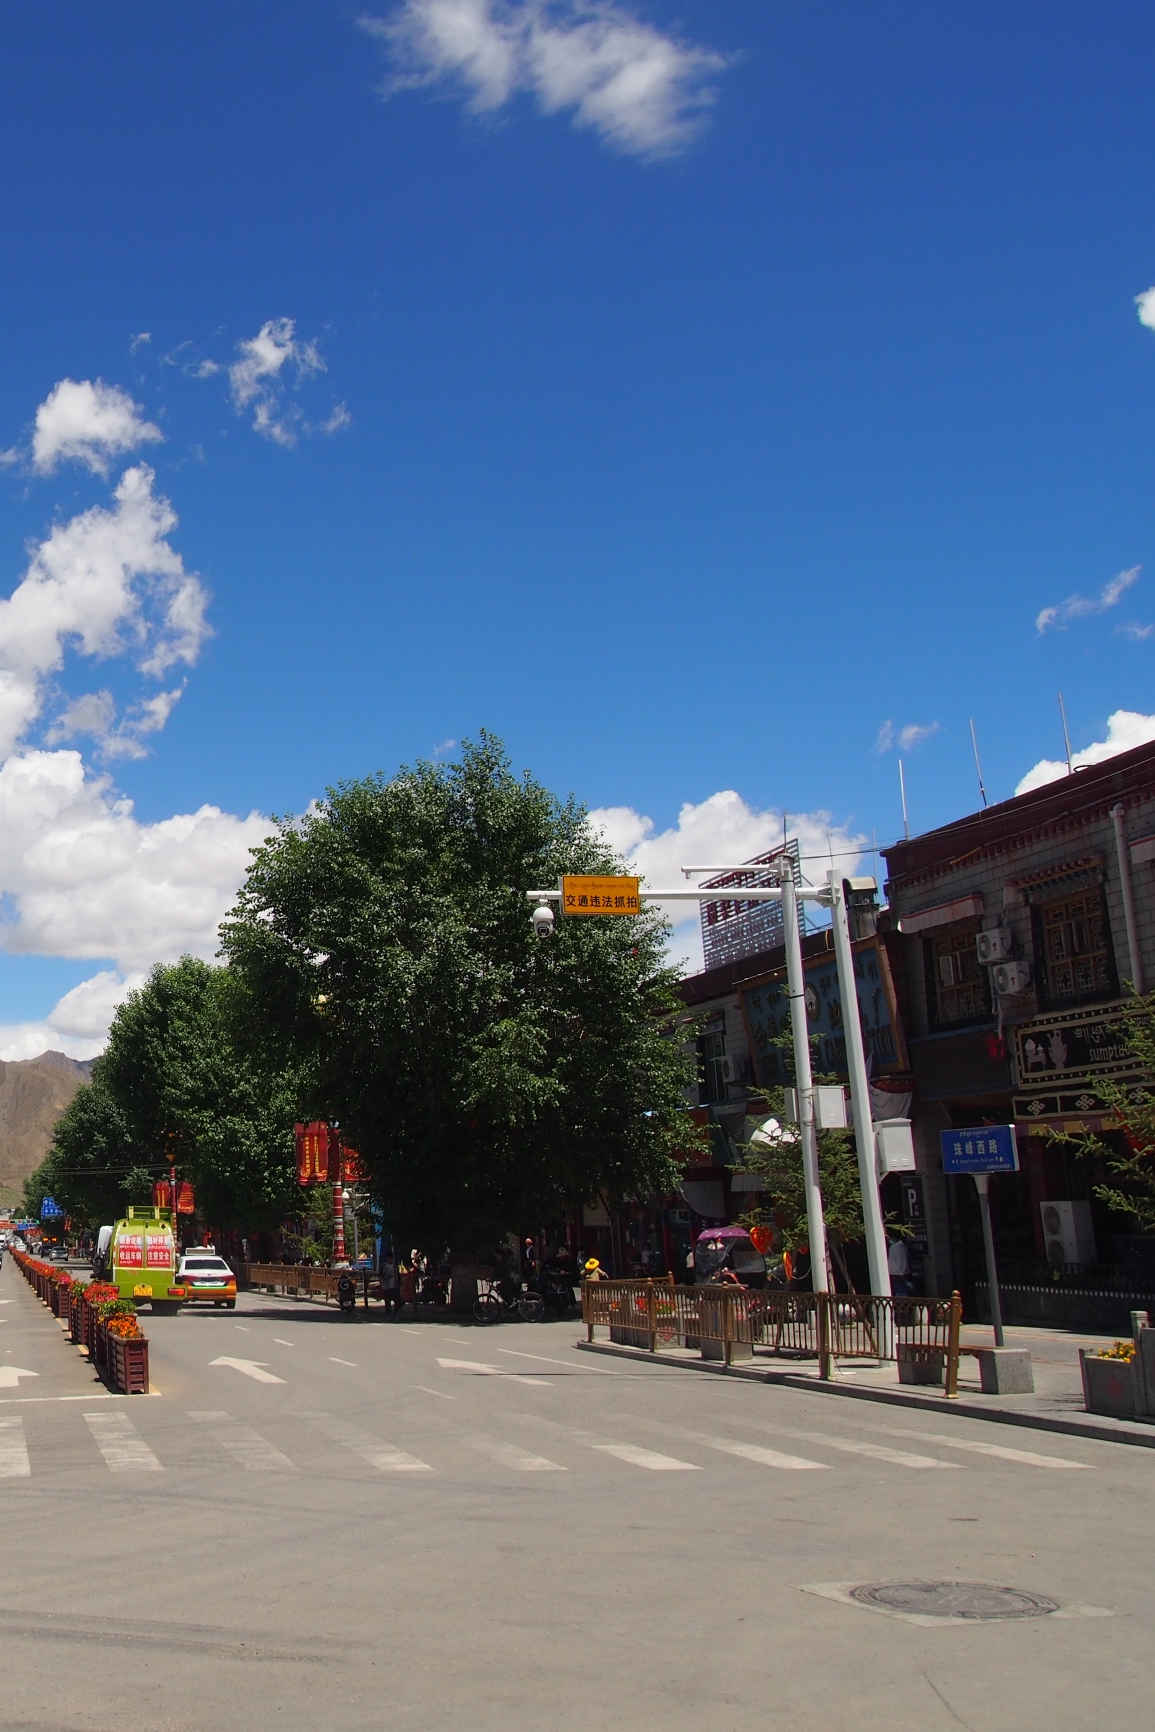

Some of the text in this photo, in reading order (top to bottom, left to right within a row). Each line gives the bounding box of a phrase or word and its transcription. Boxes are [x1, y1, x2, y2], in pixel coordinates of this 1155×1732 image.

[566, 895, 637, 908] 交通违法抓拍
[954, 1139, 998, 1157] 珠峰西路
[907, 1188, 917, 1216] P
[119, 1251, 142, 1261] 收运车辆
[147, 1251, 169, 1261] 注意安全
